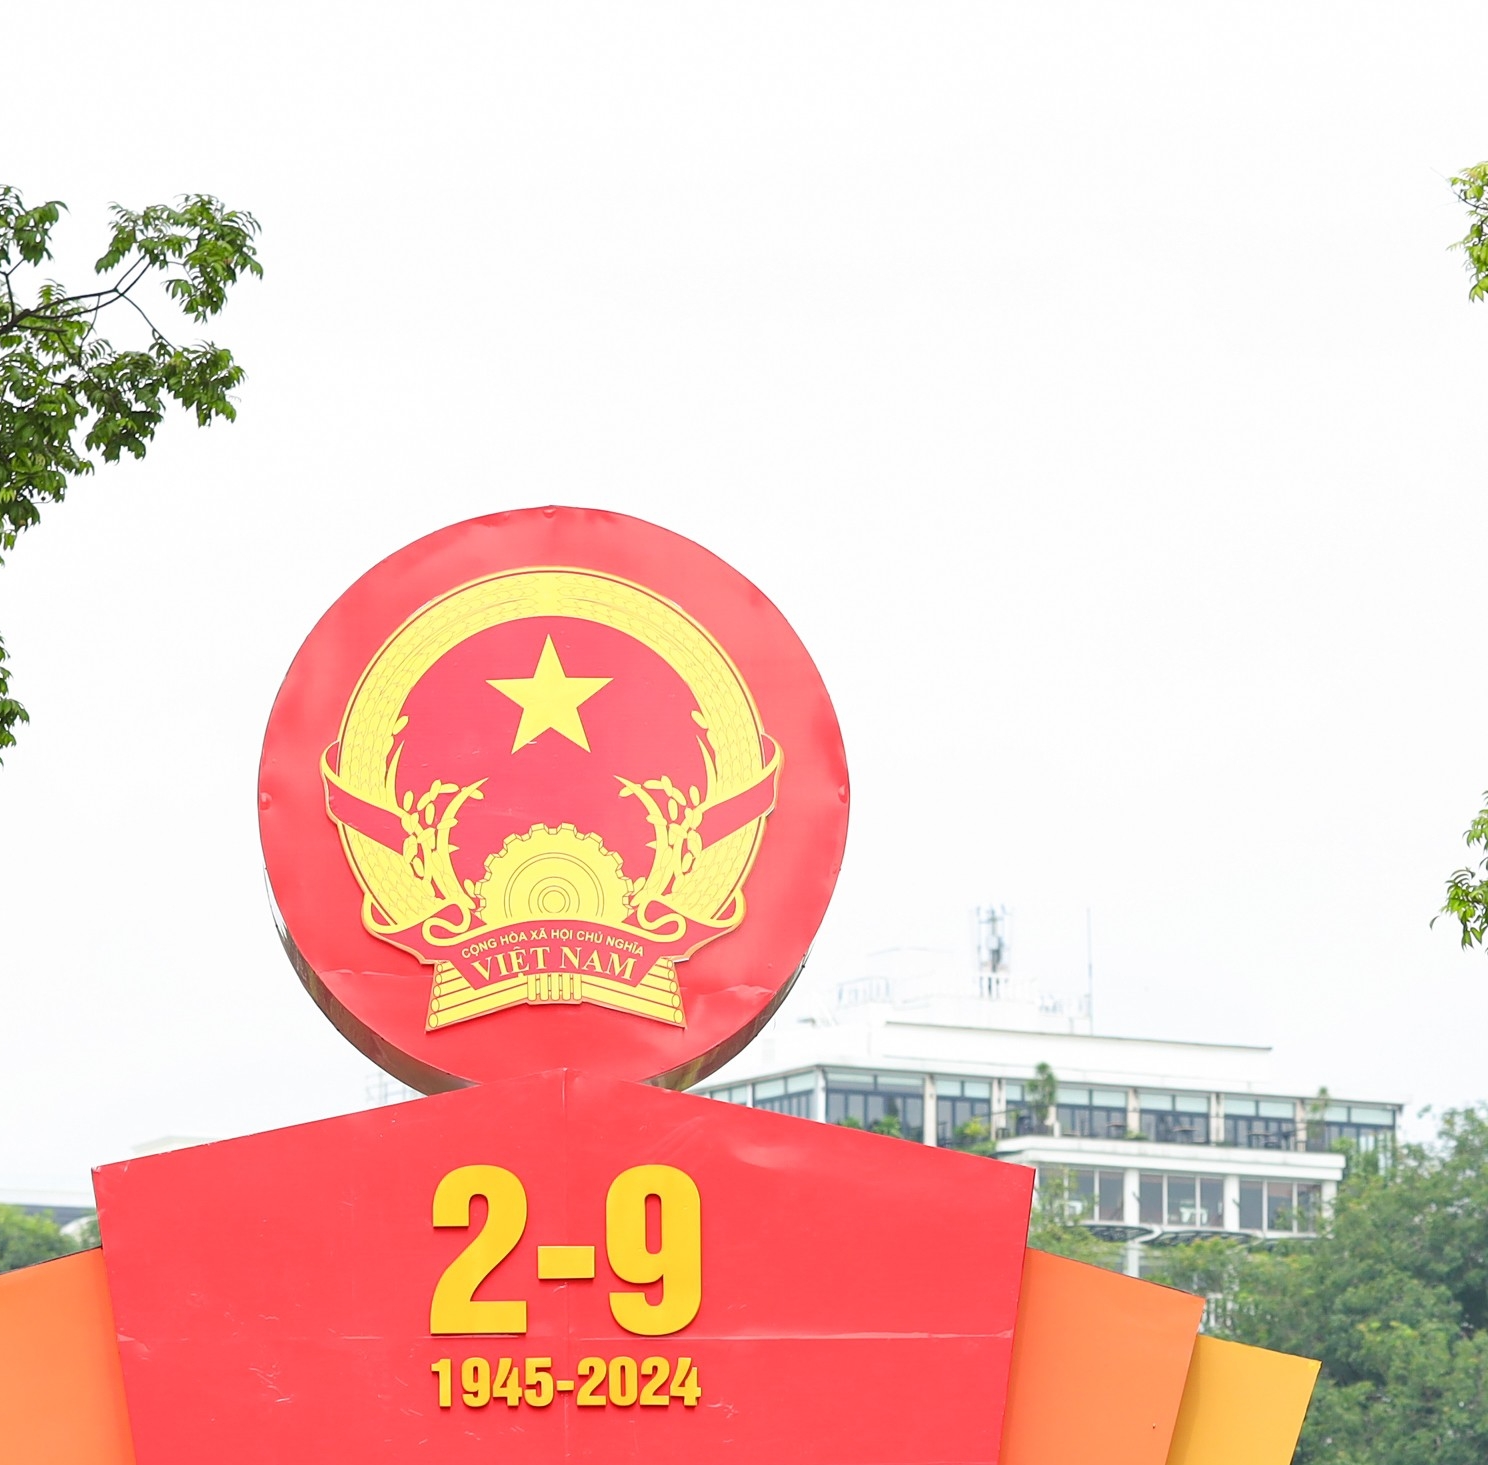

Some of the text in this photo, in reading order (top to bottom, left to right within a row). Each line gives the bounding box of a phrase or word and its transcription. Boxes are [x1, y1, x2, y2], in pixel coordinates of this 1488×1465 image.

[470, 945, 638, 982] VIỆT NAM
[530, 927, 548, 941] XÃ
[576, 930, 603, 944] CHỦ
[606, 936, 644, 957] NGHĨA
[429, 1163, 702, 1336] 2-9
[431, 1356, 702, 1407] 1945-2024
